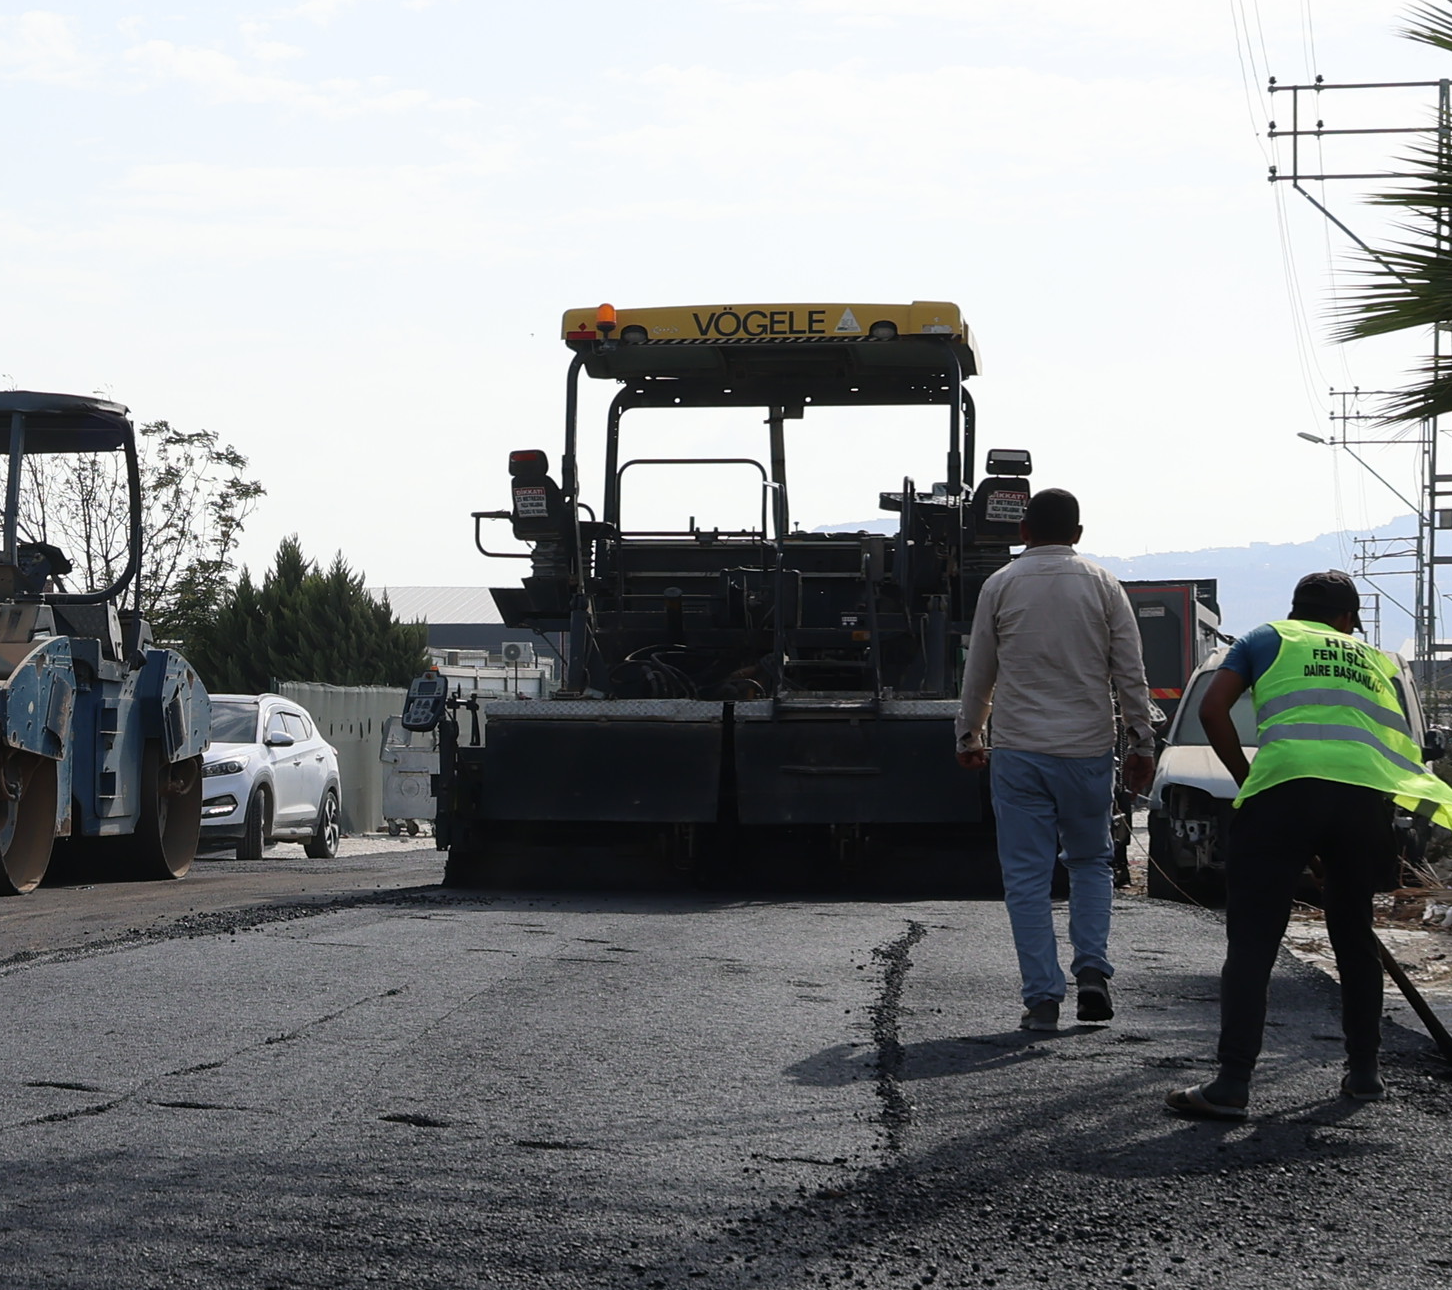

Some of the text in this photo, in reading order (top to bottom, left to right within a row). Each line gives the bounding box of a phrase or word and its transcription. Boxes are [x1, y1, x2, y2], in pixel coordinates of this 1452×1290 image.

[692, 307, 826, 337] VÖGELE
[1313, 649, 1338, 662] FEN
[1304, 662, 1331, 677] DAİRE
